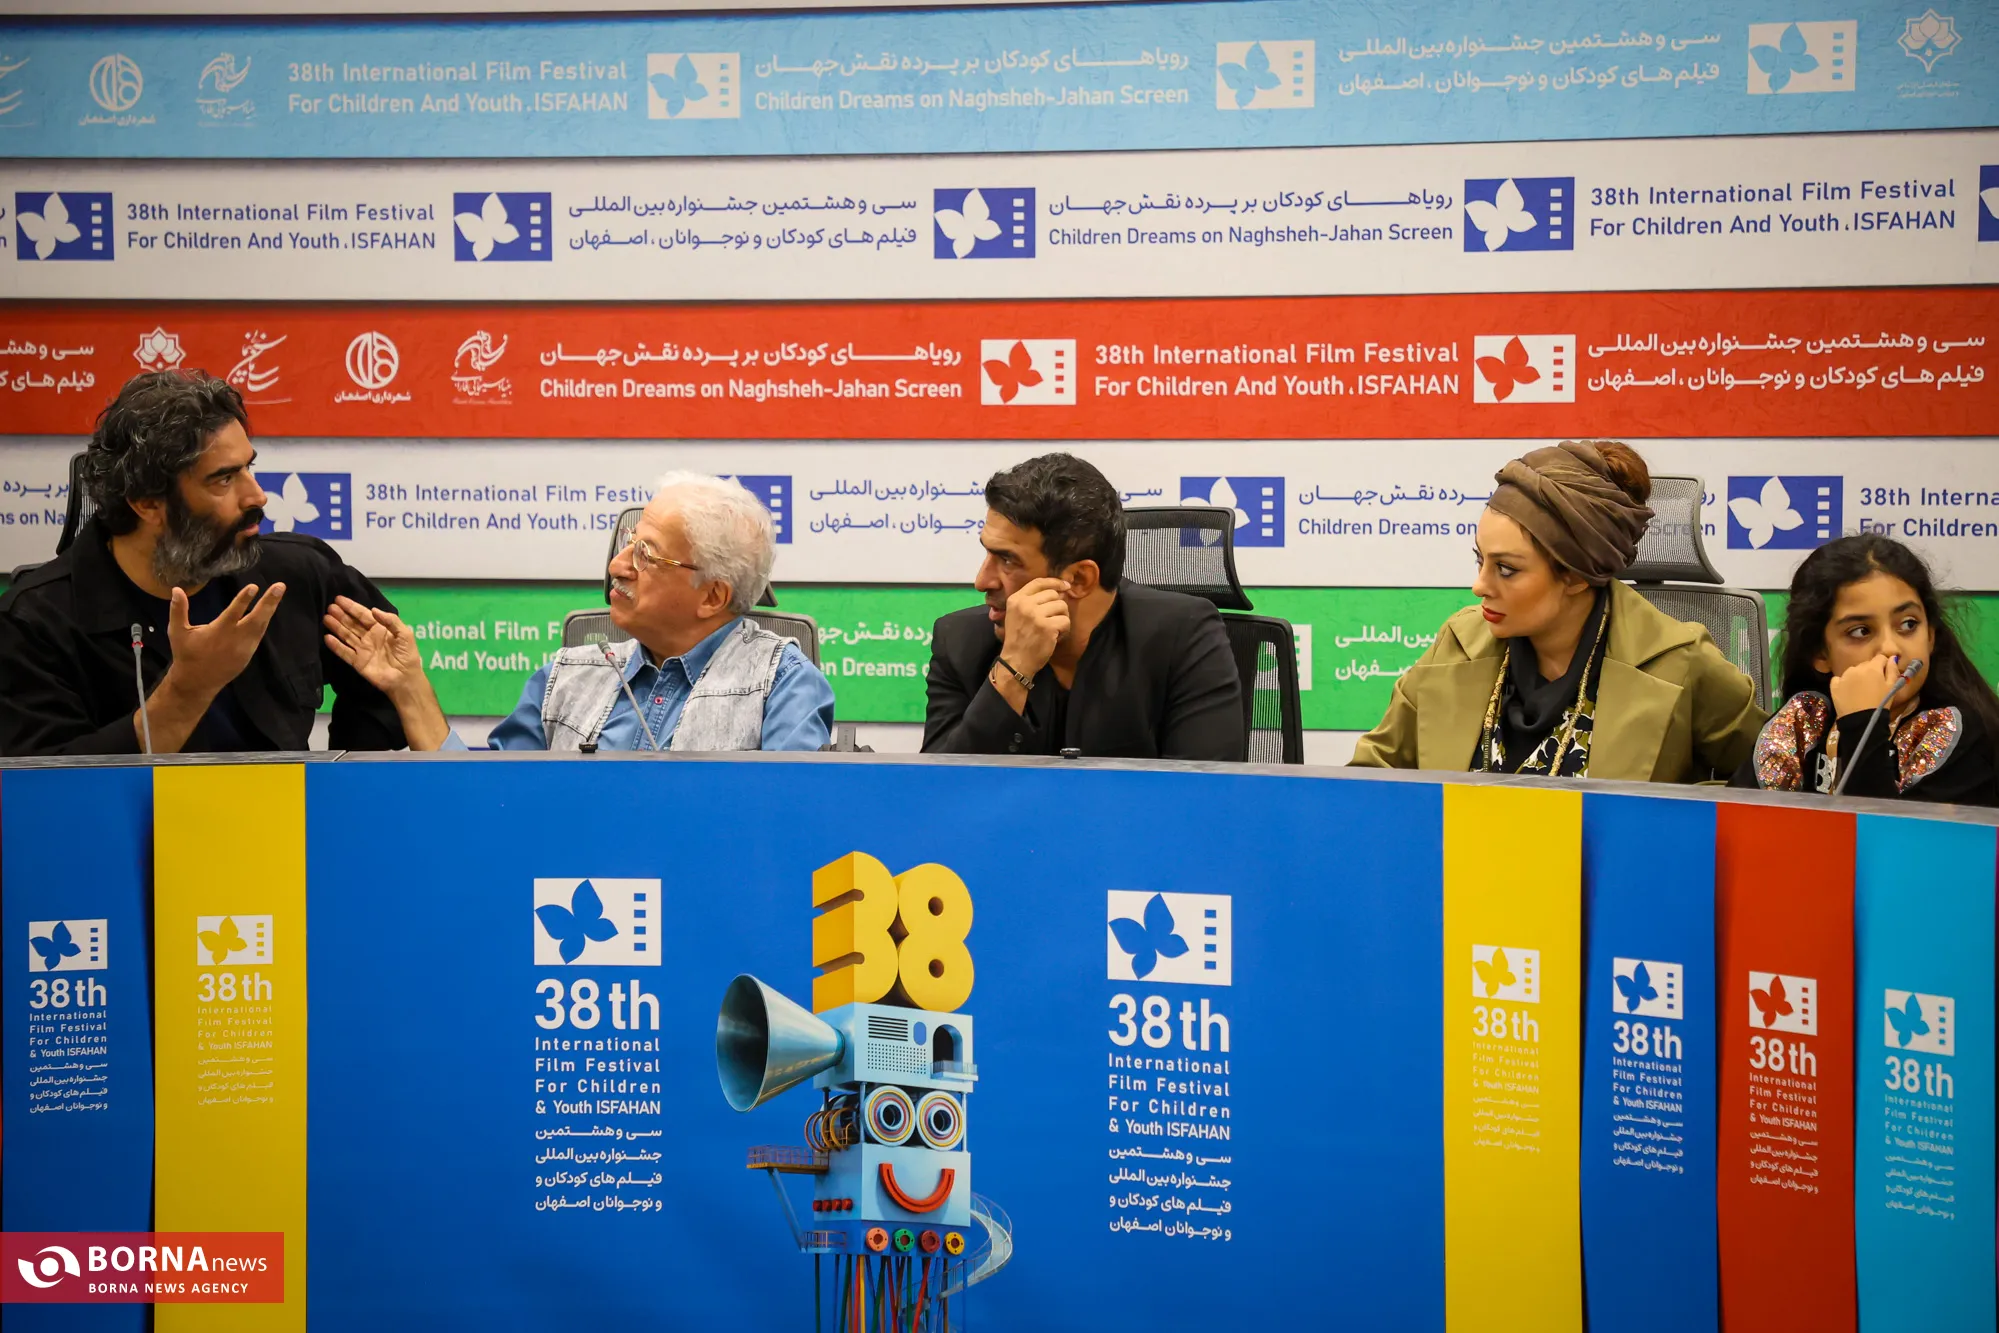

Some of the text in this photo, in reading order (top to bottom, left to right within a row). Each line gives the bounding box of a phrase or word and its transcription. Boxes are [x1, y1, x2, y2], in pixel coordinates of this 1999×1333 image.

[288, 61, 627, 82] 38th International Film Festival
[288, 94, 322, 113] For
[328, 93, 414, 113] Children
[420, 93, 459, 113] And
[755, 85, 1189, 111] Children Dreams on Naghsheh-Jahan Screen
[1262, 191, 1325, 212] کودکان
[1327, 188, 1453, 211] رویاهای
[1592, 179, 1954, 205] 38th International Film Festival
[128, 204, 434, 220] 38th International Film Festival
[872, 200, 917, 215] سی
[1185, 195, 1238, 214] پرده
[1241, 197, 1258, 214] بر
[1050, 224, 1452, 246] Children Dreams on Naghsheh-Jahan Screen
[1591, 219, 1625, 236] For
[1633, 217, 1721, 235] Children
[1730, 215, 1770, 233] And
[128, 232, 157, 248] For
[164, 232, 240, 249] Children
[248, 233, 282, 248] And
[569, 229, 648, 250] اصفهان
[766, 228, 825, 249] کودکان
[877, 227, 917, 251] فیلم
[1096, 342, 1458, 364] 38th International Film Festival
[1933, 335, 1986, 353] سی
[682, 346, 739, 368] پرده
[742, 349, 759, 367] بر
[763, 342, 829, 367] کودکان
[830, 342, 962, 367] رویاهای
[1096, 376, 1130, 396] For
[1137, 376, 1227, 396] Children
[1235, 376, 1276, 395] And
[1587, 368, 1676, 391] اصفهان
[1810, 366, 1879, 390] کودکان
[1937, 364, 1985, 391] فیلم
[541, 379, 962, 402] Children Dreams on Naghsheh-Jahan Screen
[367, 484, 655, 502] 38th International Film Festiv
[1861, 488, 1999, 505] 38th Interna
[19, 513, 40, 525] on
[366, 512, 395, 528] For
[403, 512, 479, 529] Children
[487, 513, 520, 529] And
[528, 513, 577, 529] Youth
[1298, 518, 1477, 535] Children Dreams on
[1903, 519, 1998, 537] Children
[494, 621, 540, 641] Film
[430, 651, 469, 670] And
[474, 651, 530, 671] Youth
[842, 657, 917, 677] Dreams
[30, 1010, 106, 1021] International
[30, 1022, 106, 1033] Film Festival
[56, 1035, 106, 1044] Children
[536, 1037, 659, 1051] International
[41, 1049, 64, 1057] Youth
[67, 1047, 106, 1056] ISFAHAN
[536, 1058, 659, 1072] Film Festival
[1109, 1053, 1229, 1074] International
[1613, 1056, 1682, 1073] International
[536, 1079, 660, 1093] For Children
[1109, 1075, 1229, 1096] Film Festival
[1613, 1069, 1681, 1086] Film Festival
[1613, 1083, 1682, 1099] For Children
[535, 1100, 661, 1114] & Youth ISFAHAN
[1109, 1096, 1229, 1118] For Children
[1613, 1095, 1683, 1113] & Youth ISFAHAN
[1109, 1118, 1230, 1140] & Youth ISFAHAN
